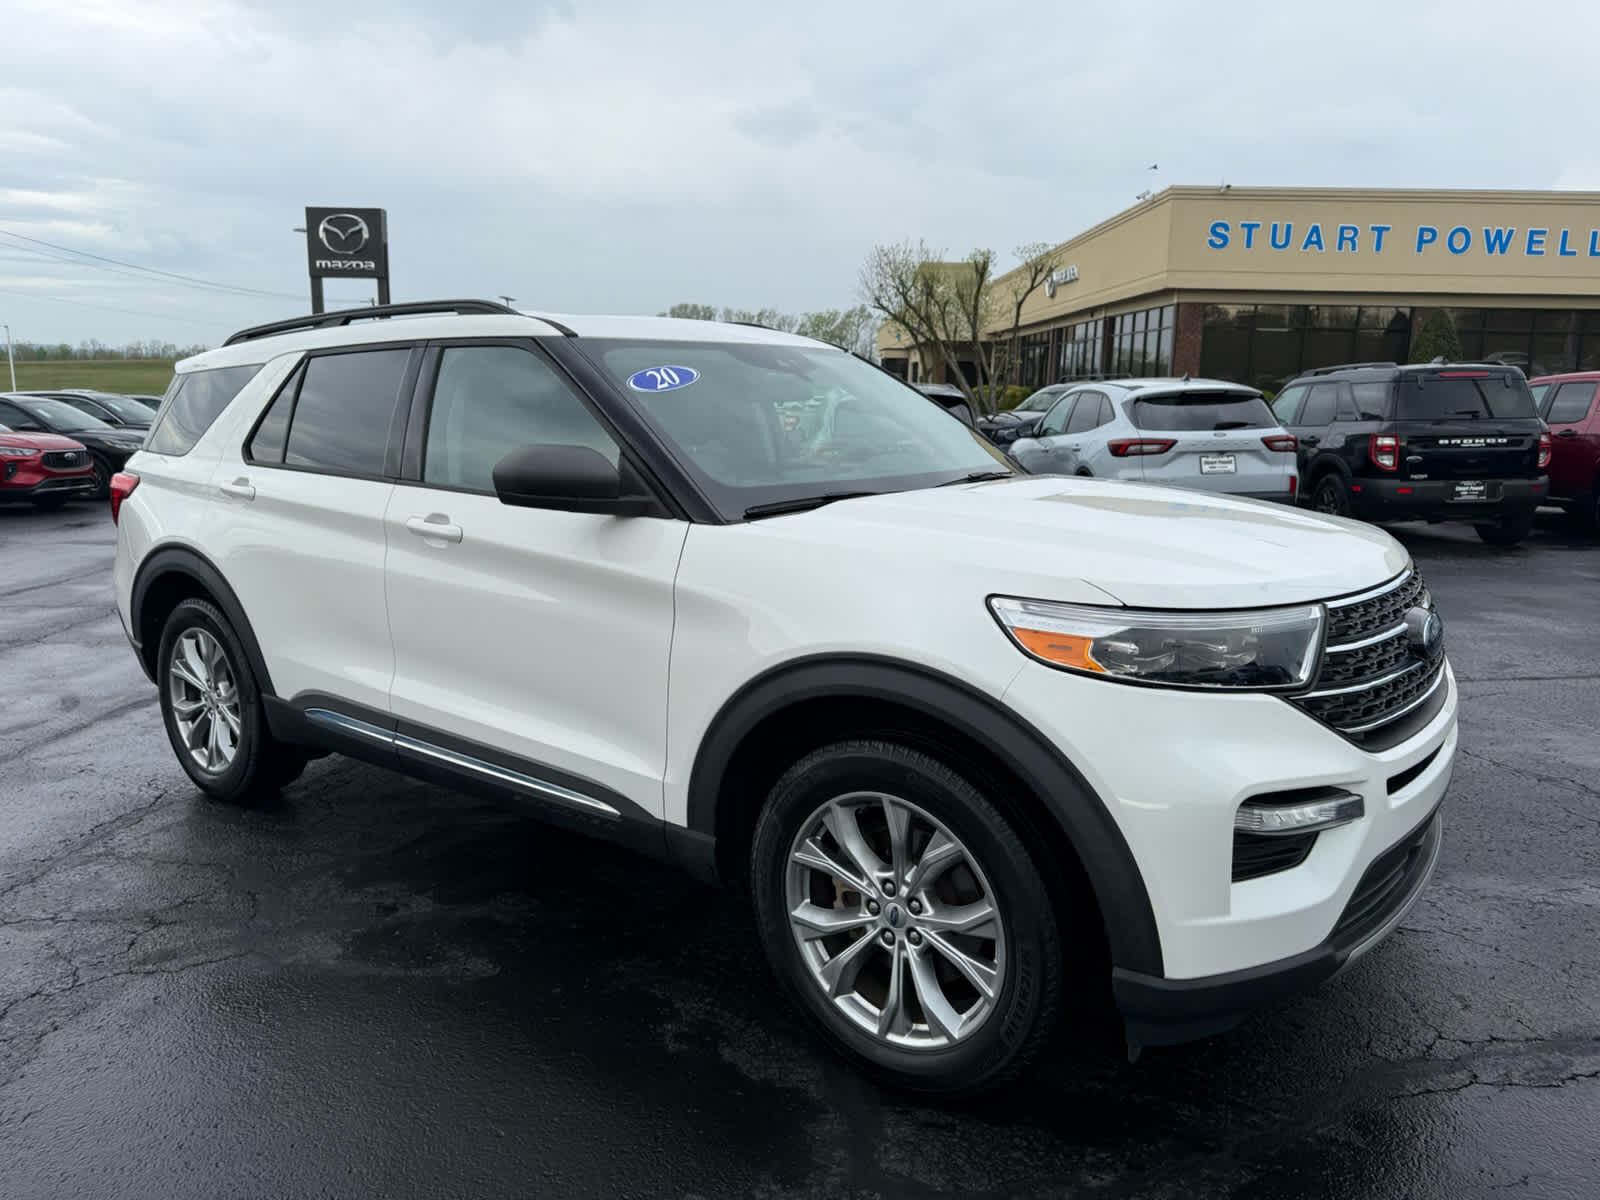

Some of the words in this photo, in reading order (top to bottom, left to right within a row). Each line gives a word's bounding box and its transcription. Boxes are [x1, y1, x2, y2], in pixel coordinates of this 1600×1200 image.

[1207, 221, 1391, 252] STUART
[1415, 226, 1600, 257] POWELL
[315, 260, 376, 270] mazda
[646, 367, 680, 390] 20
